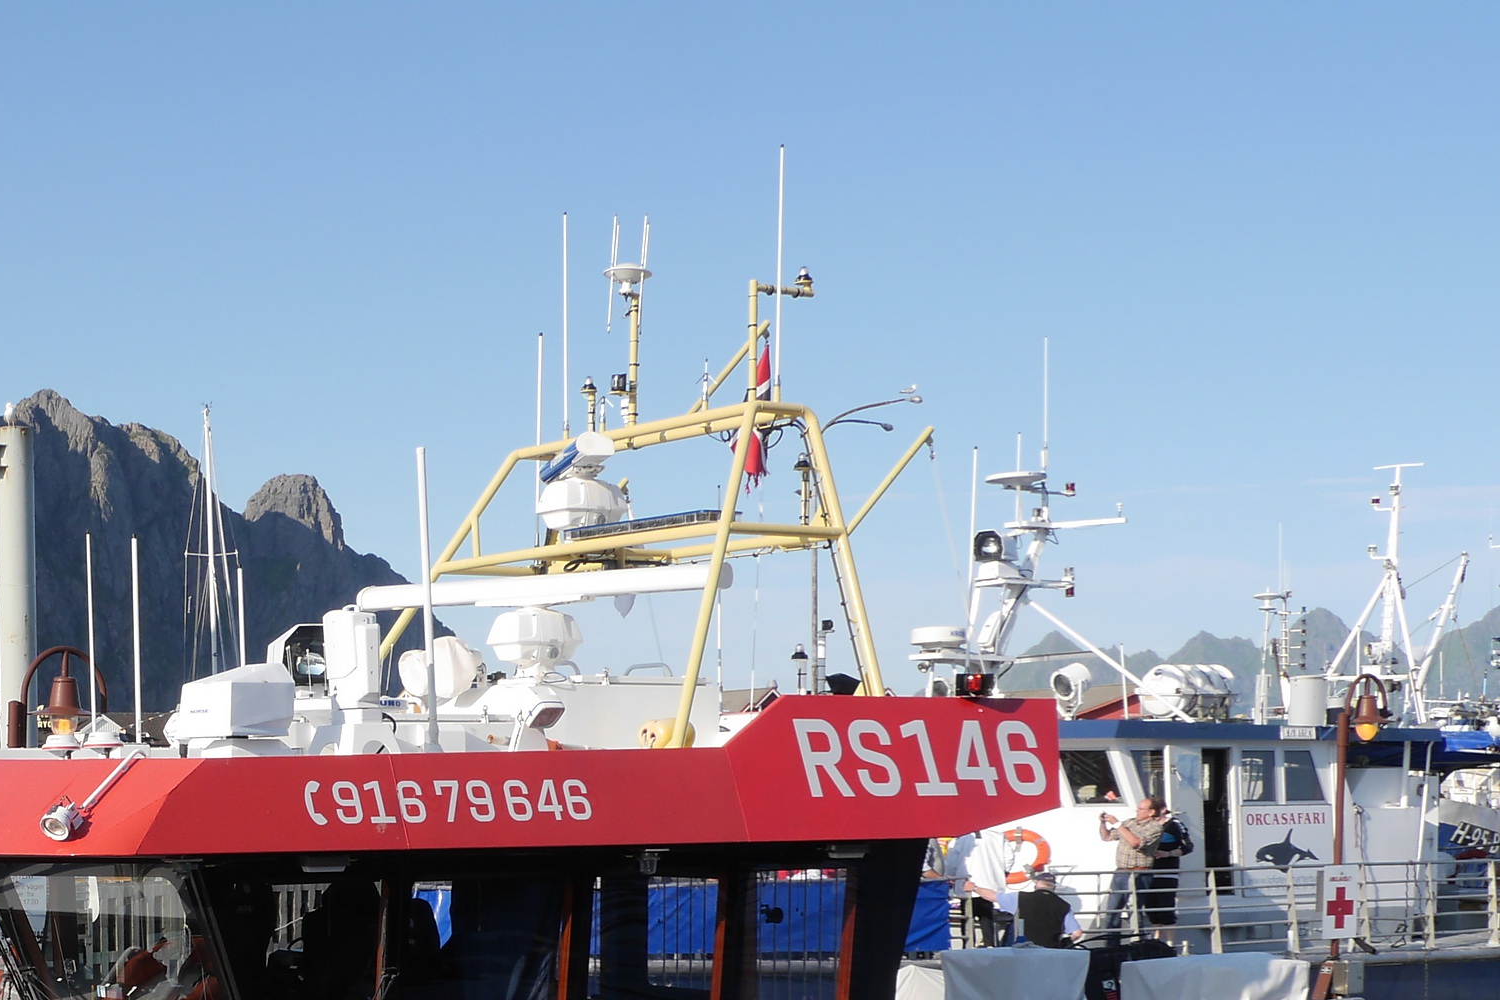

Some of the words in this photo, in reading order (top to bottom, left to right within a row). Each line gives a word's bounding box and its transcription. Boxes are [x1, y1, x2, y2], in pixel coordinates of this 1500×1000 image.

[792, 718, 1048, 798] RS146
[335, 780, 427, 826] 916
[432, 779, 496, 823] 79
[503, 778, 593, 823] 646
[1246, 812, 1326, 826] ORCASAFARI
